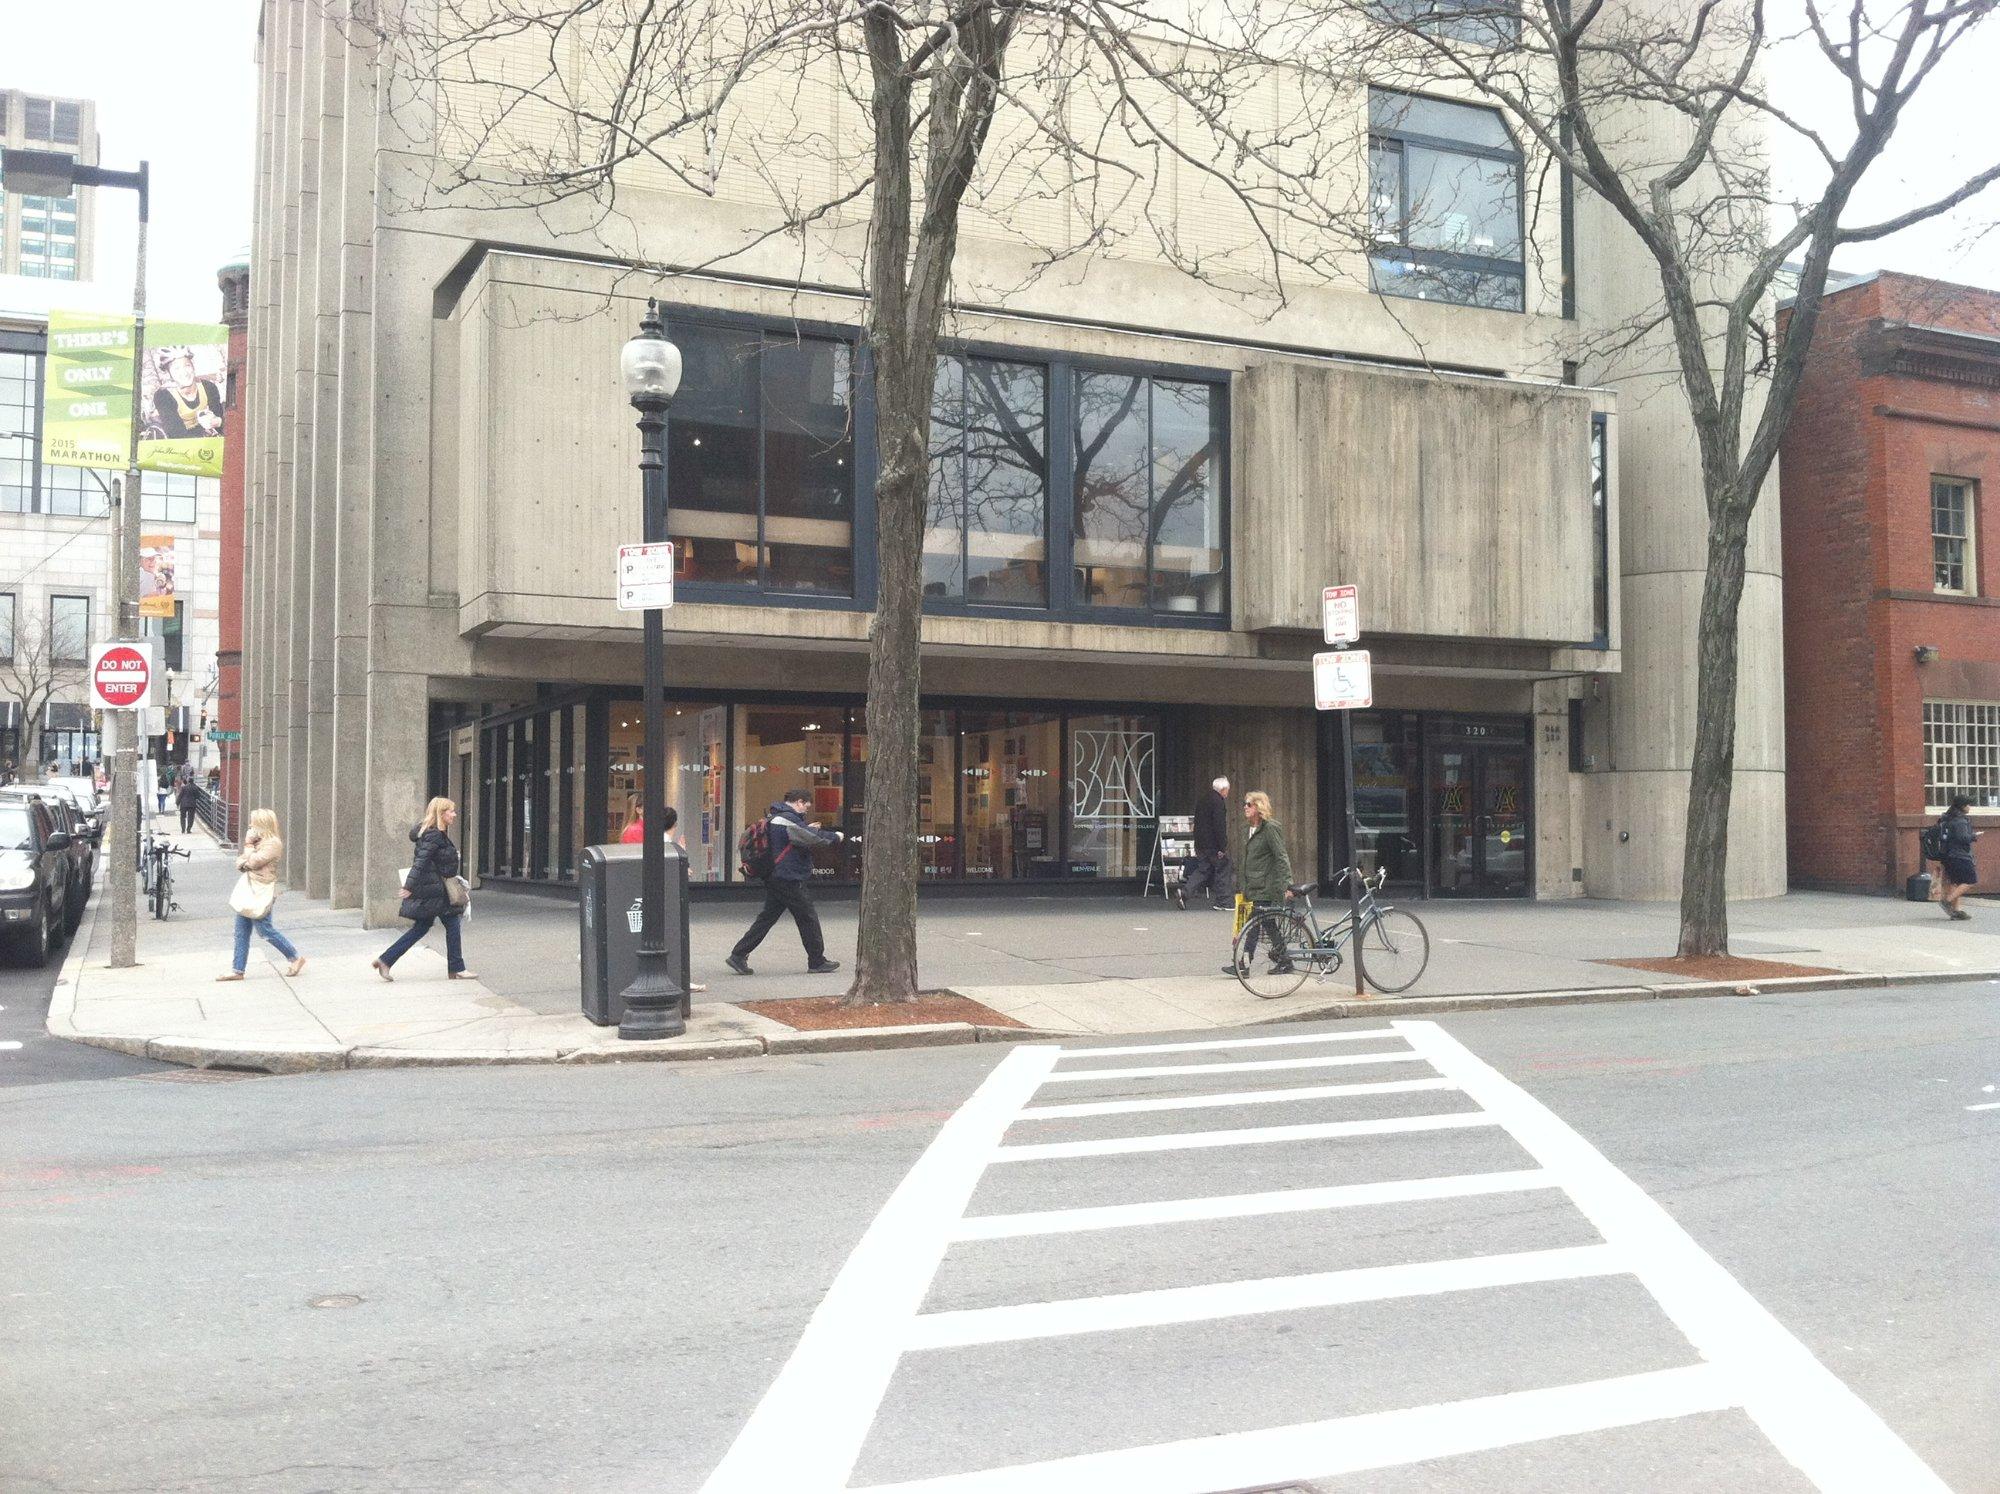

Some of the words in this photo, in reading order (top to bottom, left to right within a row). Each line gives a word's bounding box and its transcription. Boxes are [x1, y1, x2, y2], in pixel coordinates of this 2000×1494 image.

[54, 330, 128, 349] THERE'S
[64, 366, 114, 384] ONLY
[69, 402, 108, 417] ONE
[51, 438, 76, 449] 2015
[50, 449, 121, 463] MARATHON
[1334, 600, 1347, 609] NO
[101, 660, 117, 670] DO
[121, 660, 142, 670] NOT
[105, 683, 137, 693] ENTER
[1465, 726, 1486, 736] 320
